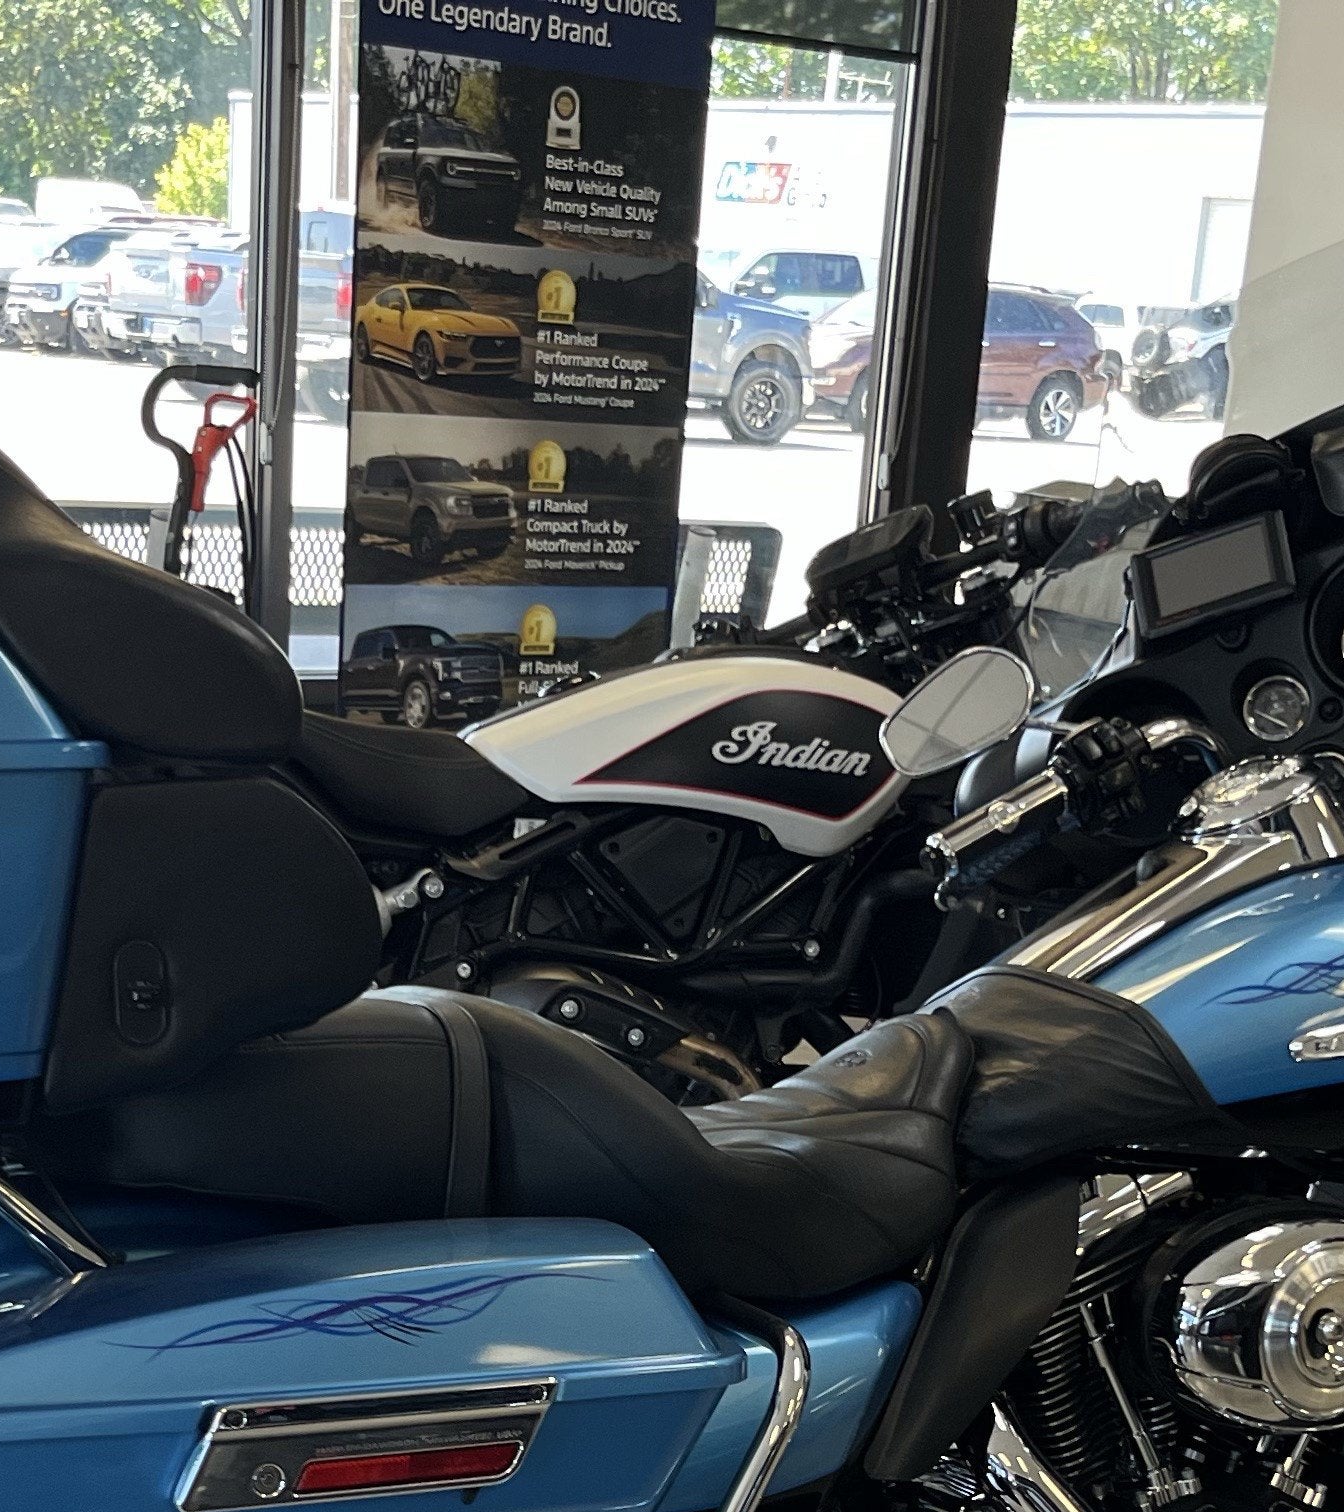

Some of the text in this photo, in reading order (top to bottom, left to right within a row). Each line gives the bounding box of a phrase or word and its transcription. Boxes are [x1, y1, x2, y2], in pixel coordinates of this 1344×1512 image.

[378, 0, 424, 19] One
[430, 0, 542, 41] Legendary
[548, 15, 612, 47] Brand.
[545, 154, 624, 177] Best-in-Class
[544, 176, 661, 205] New Vehicle Quality
[543, 198, 588, 218] Among
[590, 202, 623, 219] Small
[537, 330, 598, 347] #1 Ranked
[536, 350, 649, 373] Performance Coupe
[534, 370, 549, 387] by
[552, 371, 617, 389] MotorTrend
[619, 375, 633, 390] in
[527, 499, 588, 514] #1 Ranked
[526, 518, 629, 537] Compact Truck by
[525, 539, 592, 553] MotorTrend
[593, 539, 605, 553] in
[519, 661, 579, 675] #1 Ranked
[711, 720, 871, 776] Indian
